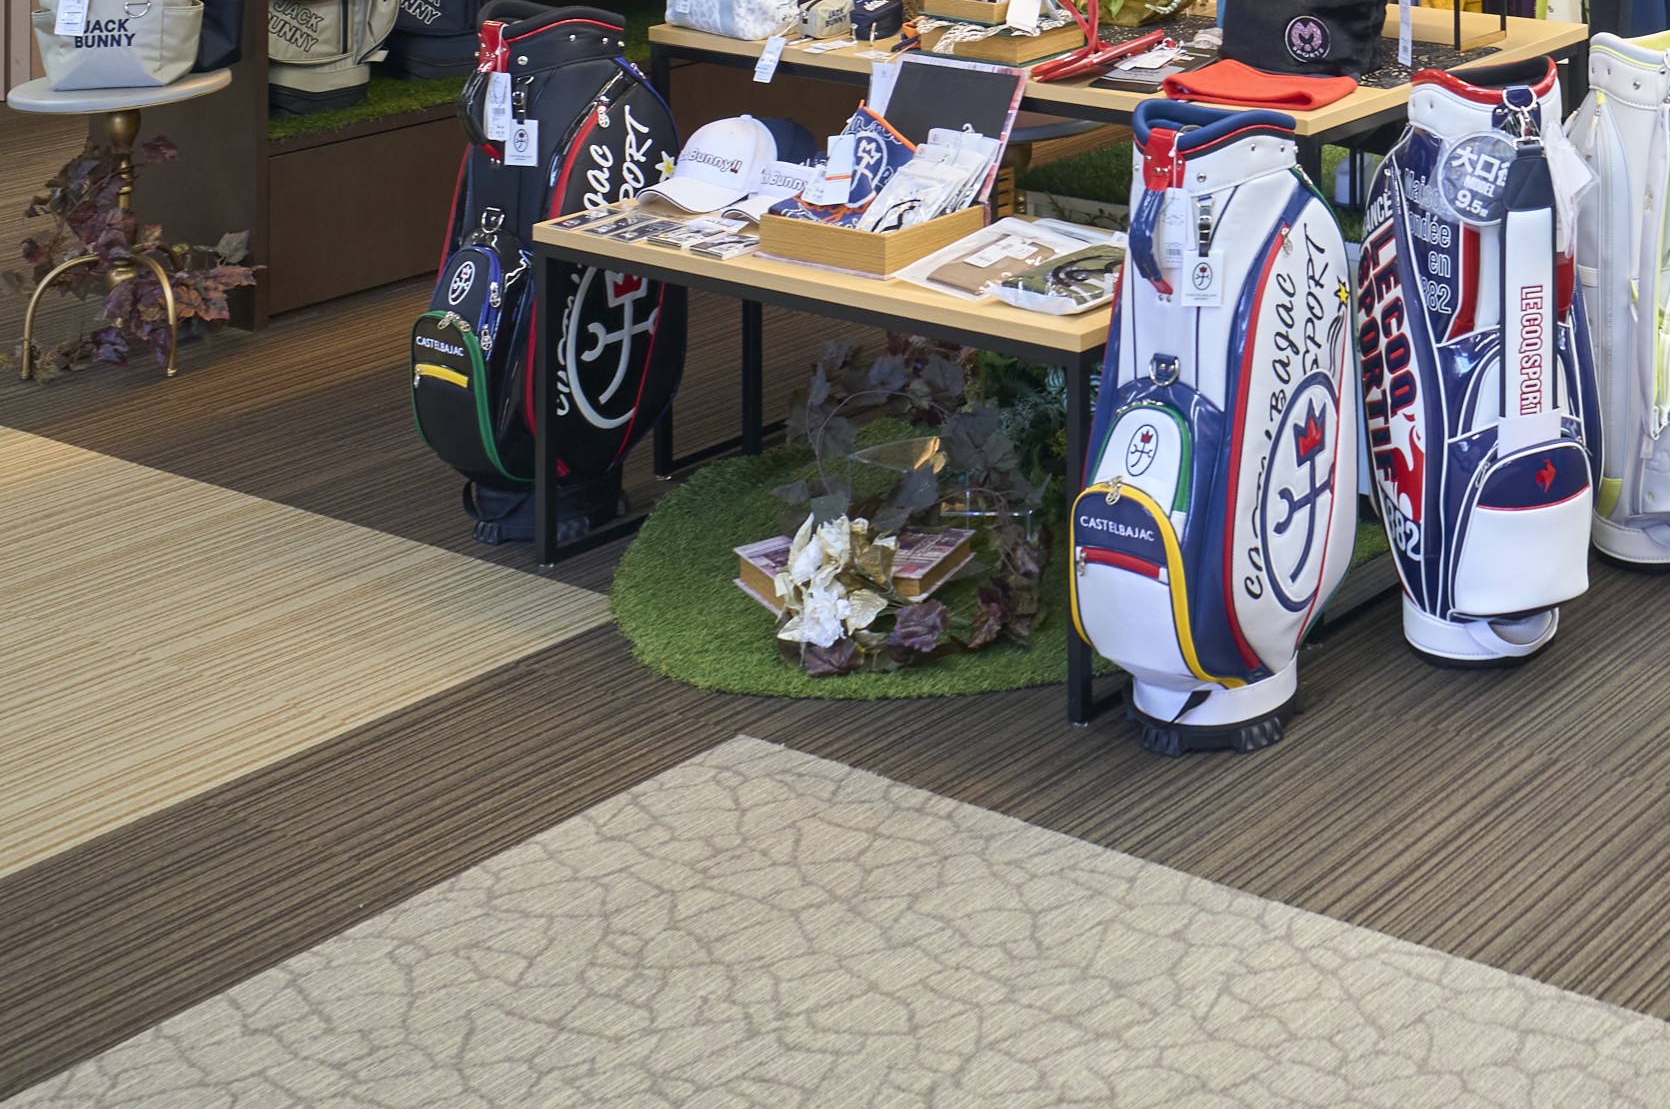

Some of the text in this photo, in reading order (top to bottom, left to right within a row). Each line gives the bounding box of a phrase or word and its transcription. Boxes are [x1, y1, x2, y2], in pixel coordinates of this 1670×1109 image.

[84, 18, 129, 33] JACK
[824, 15, 848, 29] BUNNY
[828, 8, 846, 20] JACK
[75, 33, 136, 48] BUNNY
[1463, 175, 1496, 198] MODEL
[1408, 214, 1451, 249] ondée
[1428, 252, 1451, 278] en
[1369, 225, 1419, 419] LE COQ
[416, 335, 464, 357] CASTELBAJAC
[1519, 284, 1543, 416] LE COQ SPORT
[1357, 242, 1399, 485] SPORTIF
[1080, 516, 1154, 541] CASTELBAJAC
